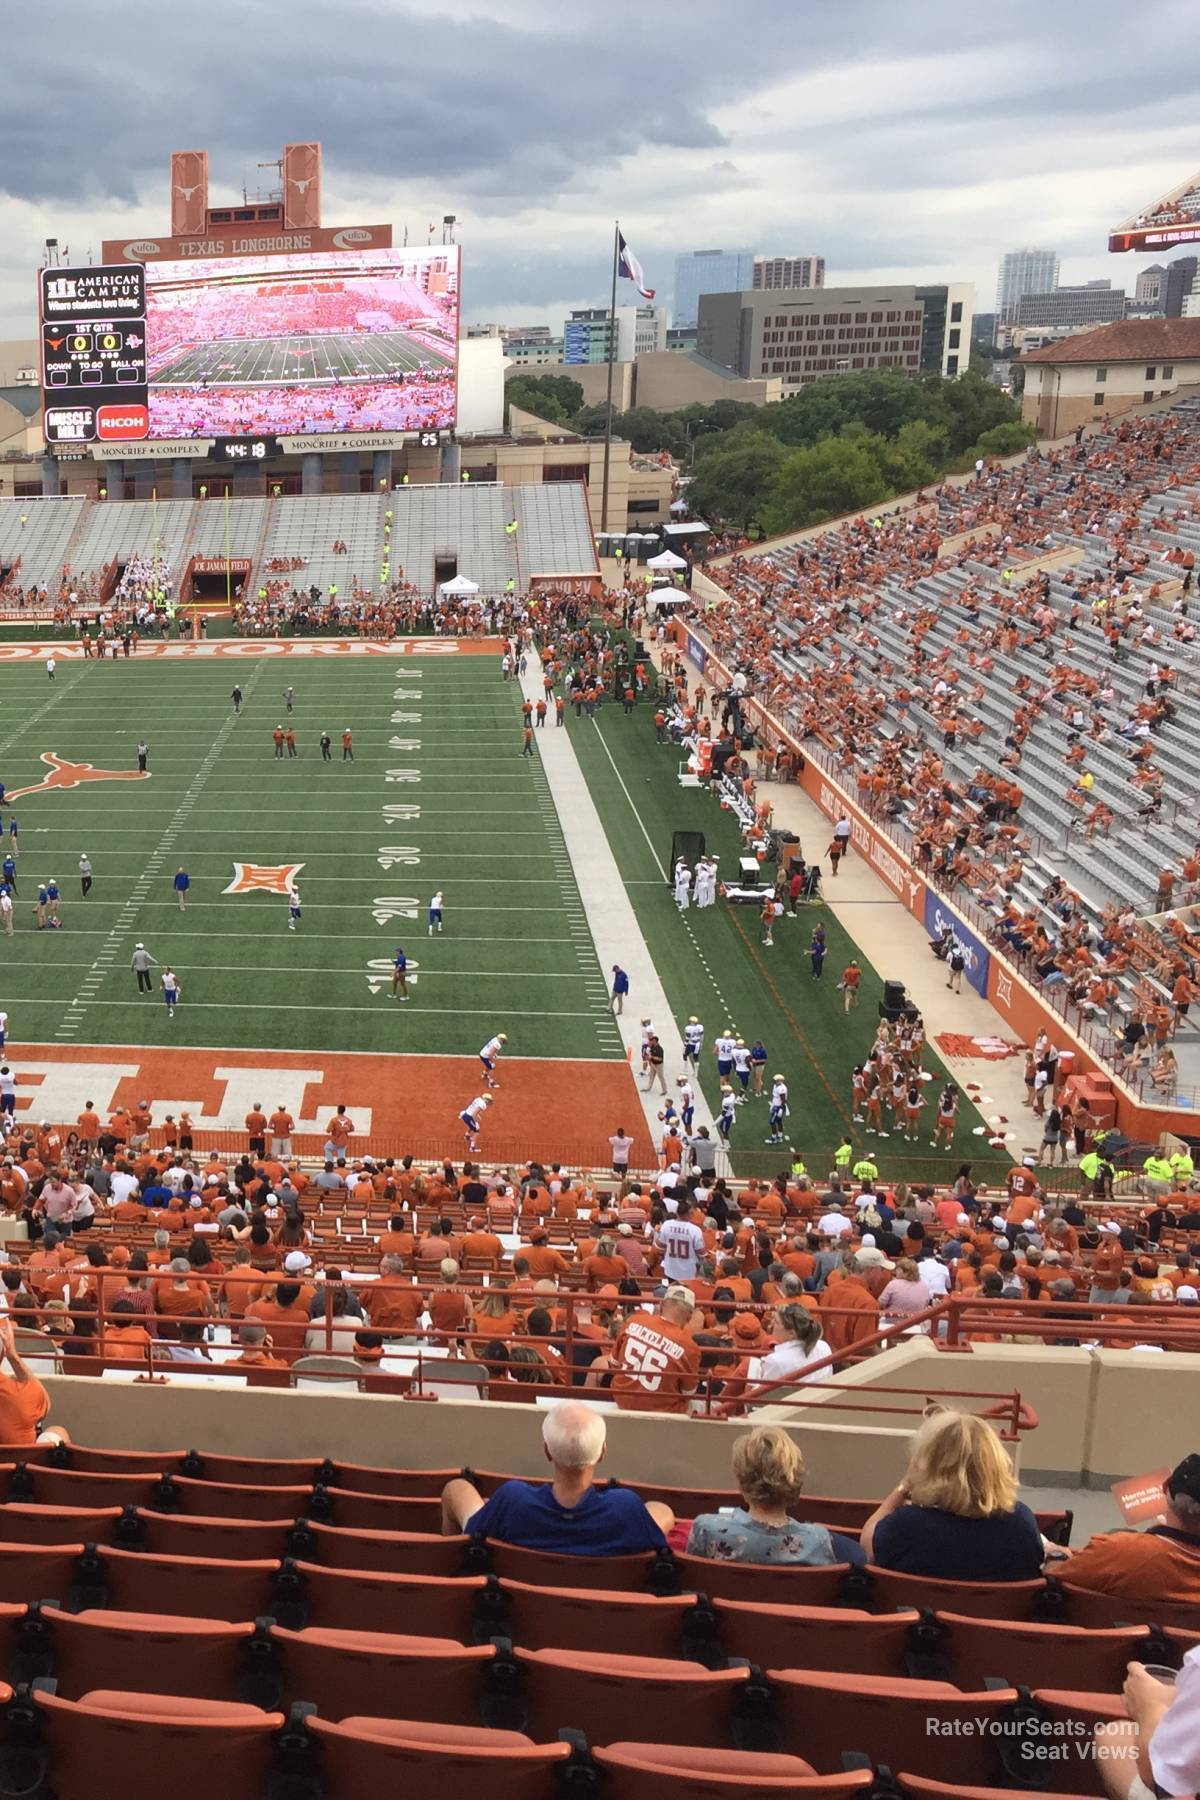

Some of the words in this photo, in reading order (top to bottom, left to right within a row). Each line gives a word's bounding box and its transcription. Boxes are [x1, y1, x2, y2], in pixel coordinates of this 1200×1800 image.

[179, 240, 224, 256] TEXAS
[232, 236, 311, 252] LONGHORNS
[78, 275, 139, 287] AMERICAN
[78, 286, 140, 297] CAMPUS
[48, 301, 71, 310] Where
[72, 300, 102, 310] students
[102, 299, 117, 308] love
[76, 324, 91, 332] 1ST
[93, 323, 113, 332] QTR
[74, 336, 86, 350] 0
[103, 335, 116, 350] 0
[92, 361, 104, 369] GO
[49, 411, 92, 426] MUSCLE
[102, 418, 144, 428] RICOH
[58, 425, 85, 438] MILK
[292, 438, 339, 449] MONCRIEF
[350, 438, 394, 448] COMPLEX
[421, 432, 438, 446] 25
[102, 447, 147, 456] MONCRIEF
[156, 446, 200, 454] COMPLEX
[194, 562, 205, 572] JOE
[231, 561, 250, 570] FIELD
[384, 769, 422, 782] 50
[382, 804, 422, 820] 40
[377, 846, 421, 864] 30
[371, 896, 420, 918] 20
[1012, 1176, 1025, 1192] 12
[670, 1226, 690, 1235] TEXAS
[668, 1238, 690, 1260] 10
[624, 1337, 668, 1392] 56
